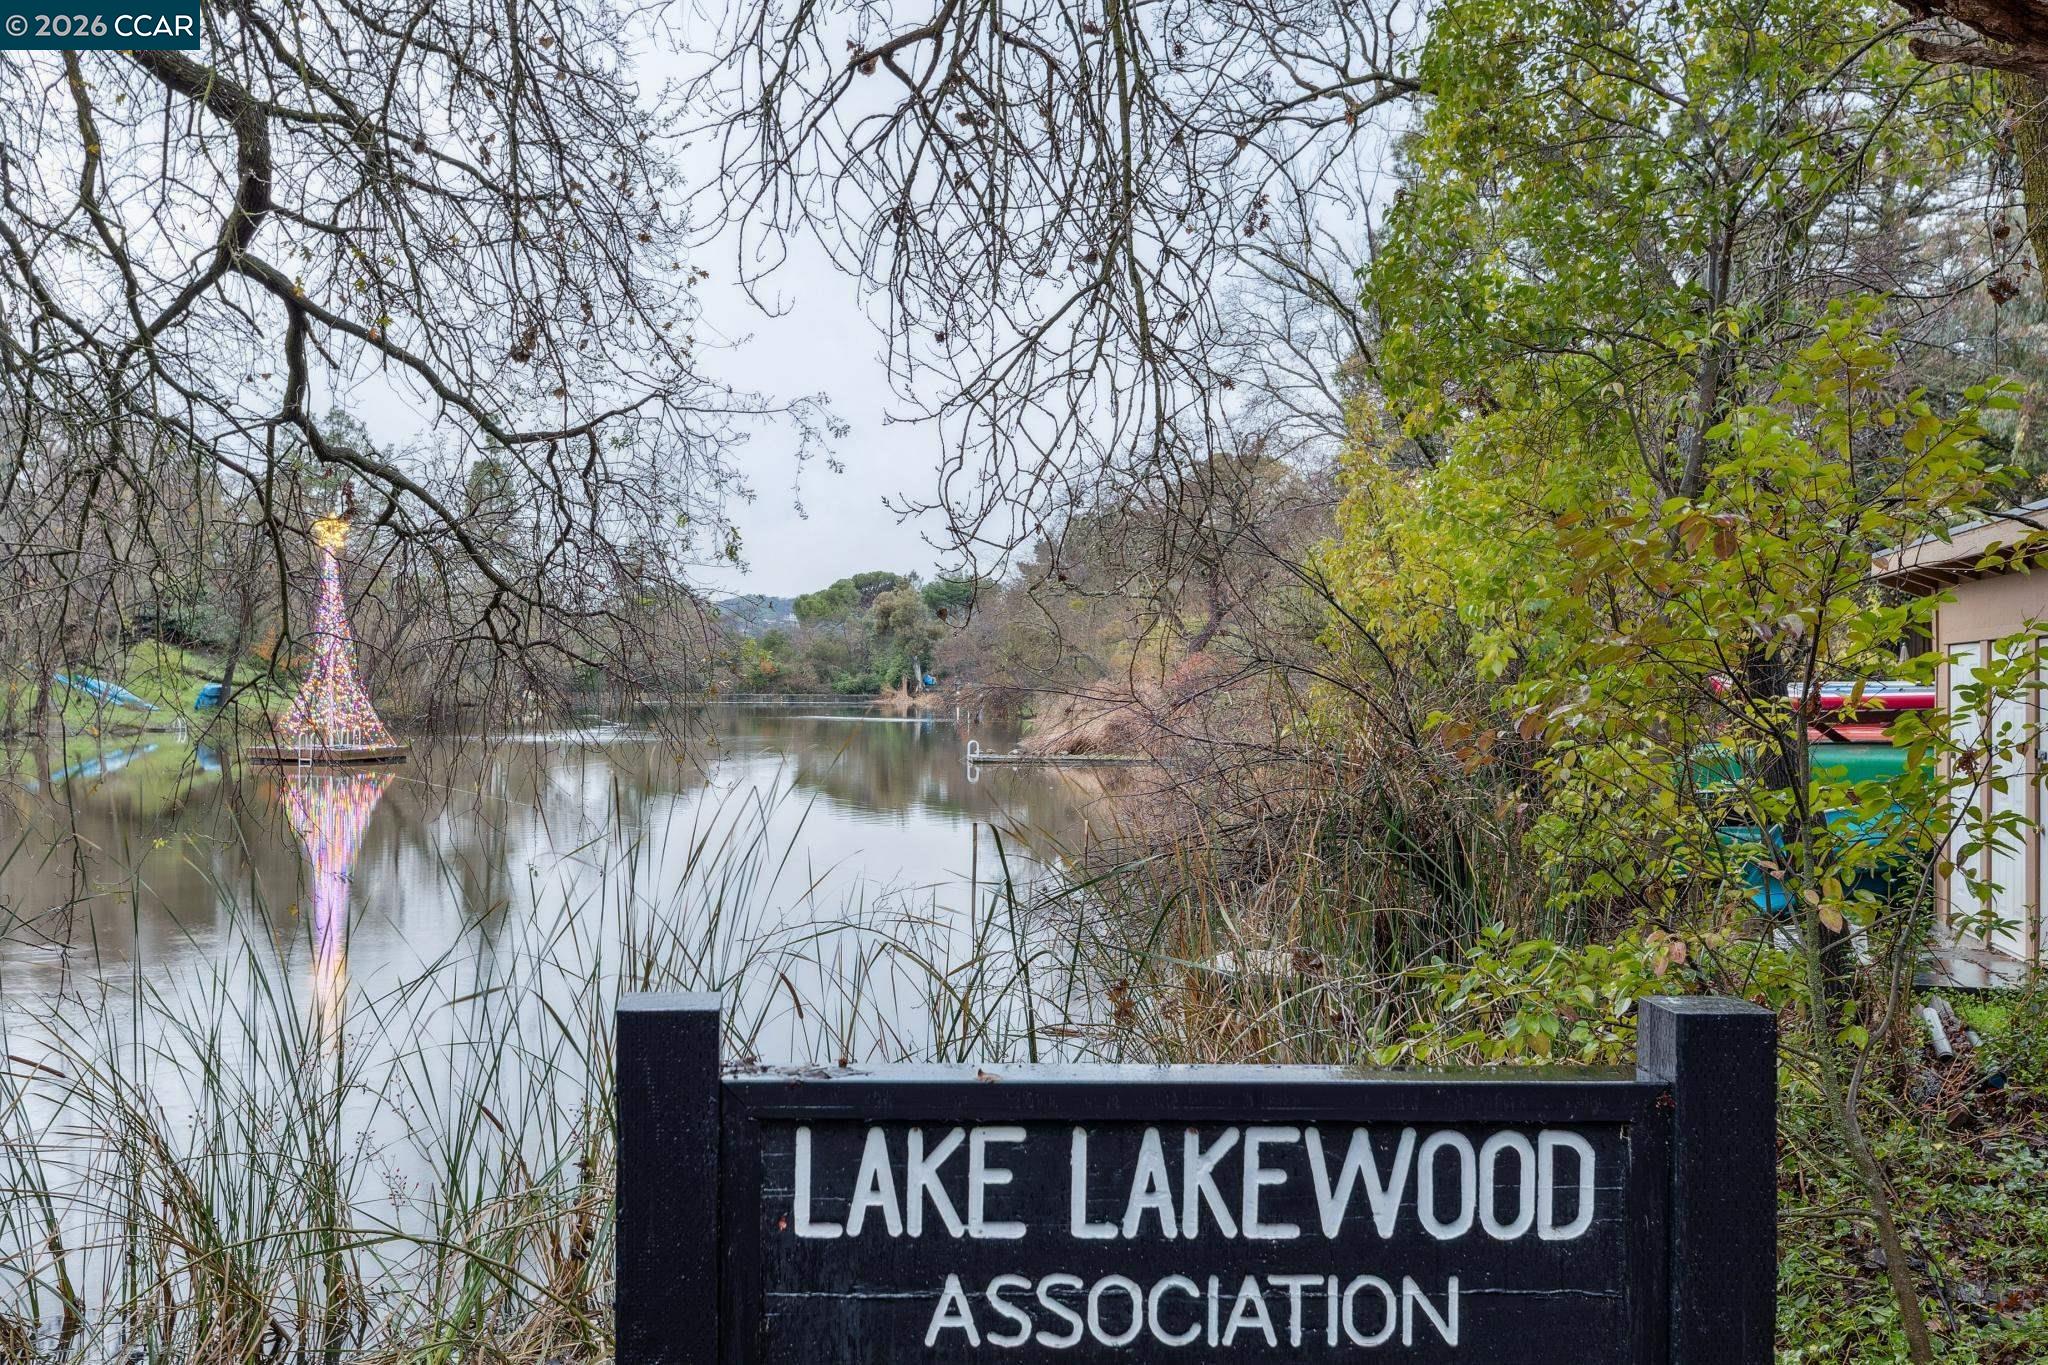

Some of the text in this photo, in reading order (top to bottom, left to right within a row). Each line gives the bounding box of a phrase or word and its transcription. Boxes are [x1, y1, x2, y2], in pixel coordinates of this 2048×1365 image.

[794, 1126, 1596, 1240] LAKE LAKEWOOD
[924, 1273, 1459, 1348] ASSOCIATION
